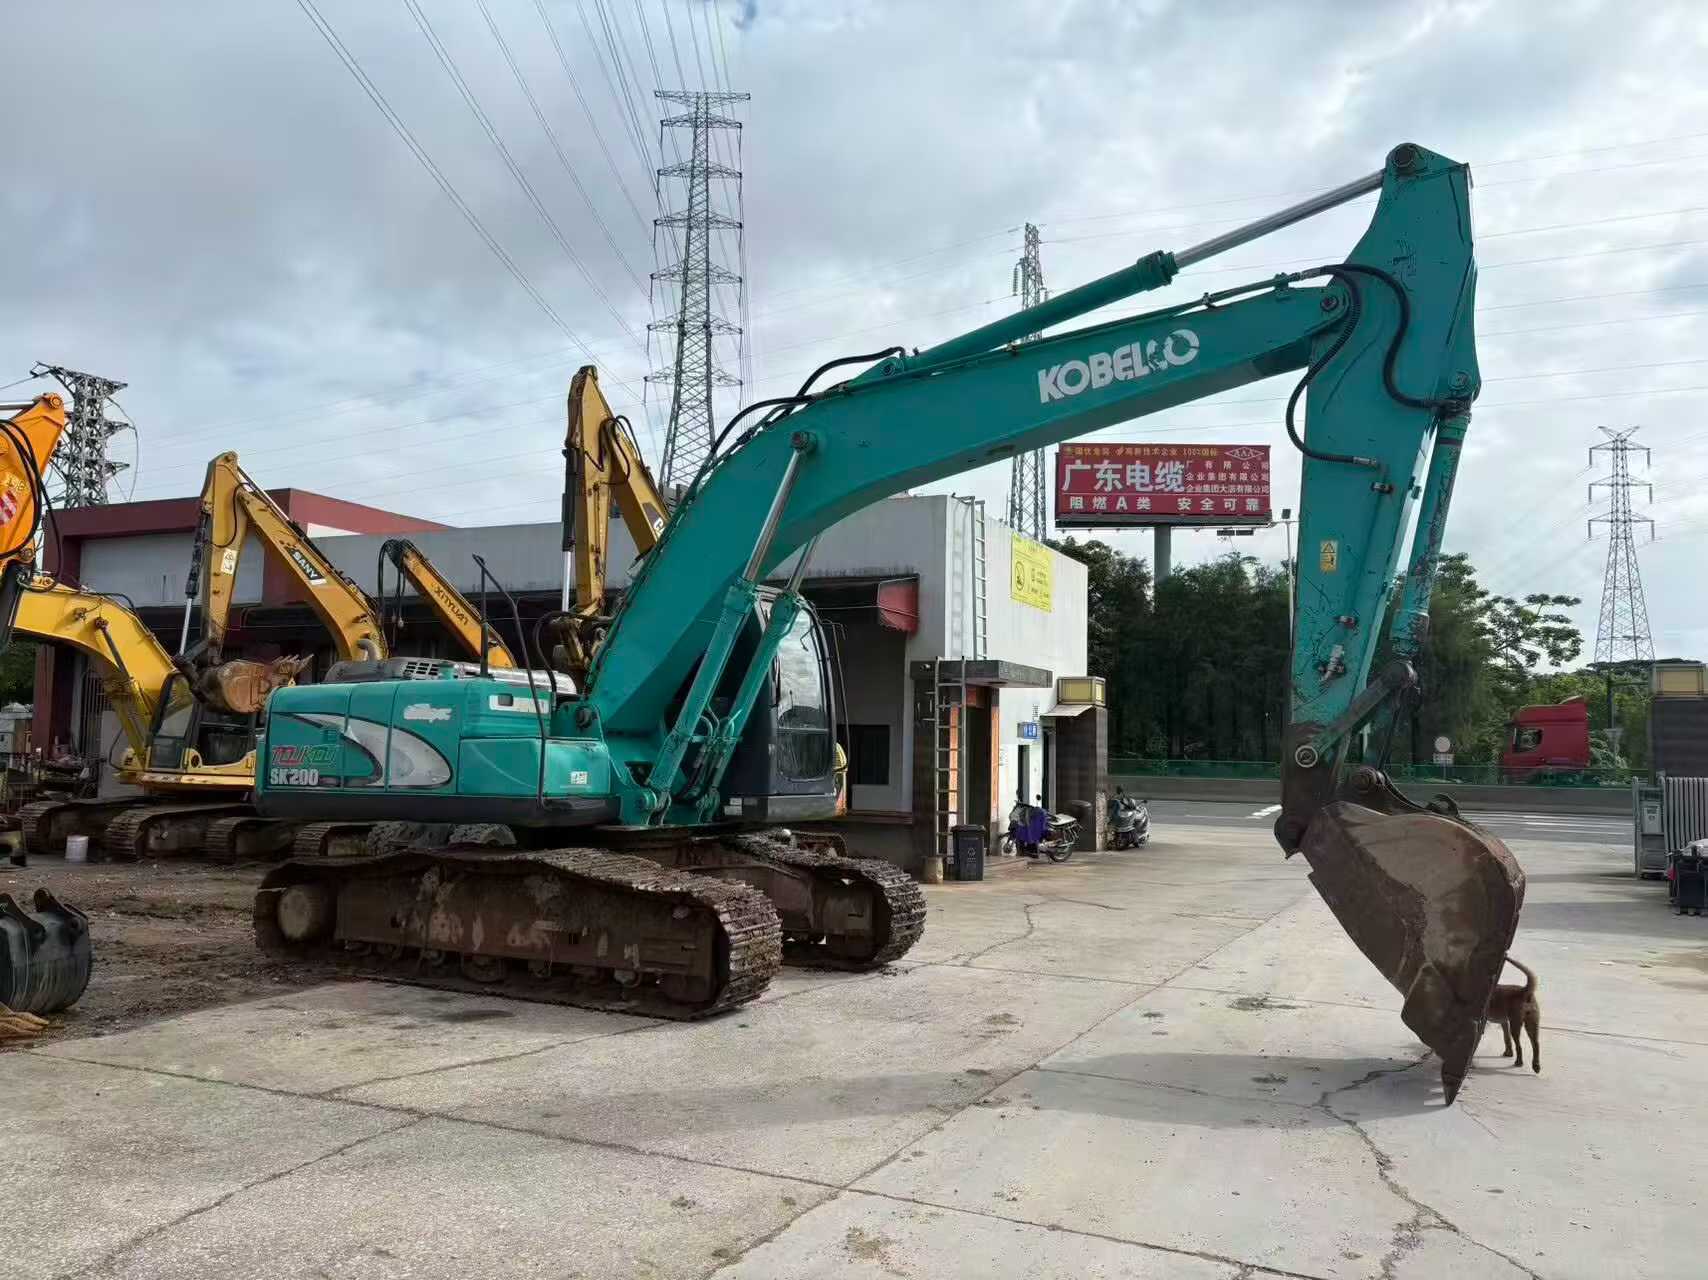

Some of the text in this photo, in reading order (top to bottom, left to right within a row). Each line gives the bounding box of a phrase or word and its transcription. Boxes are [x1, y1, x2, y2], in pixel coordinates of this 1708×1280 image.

[1062, 460, 1185, 491] 广东电缆
[1177, 497, 1260, 511] 安全可靠
[293, 551, 318, 578] SANY
[270, 768, 319, 786] SK200
